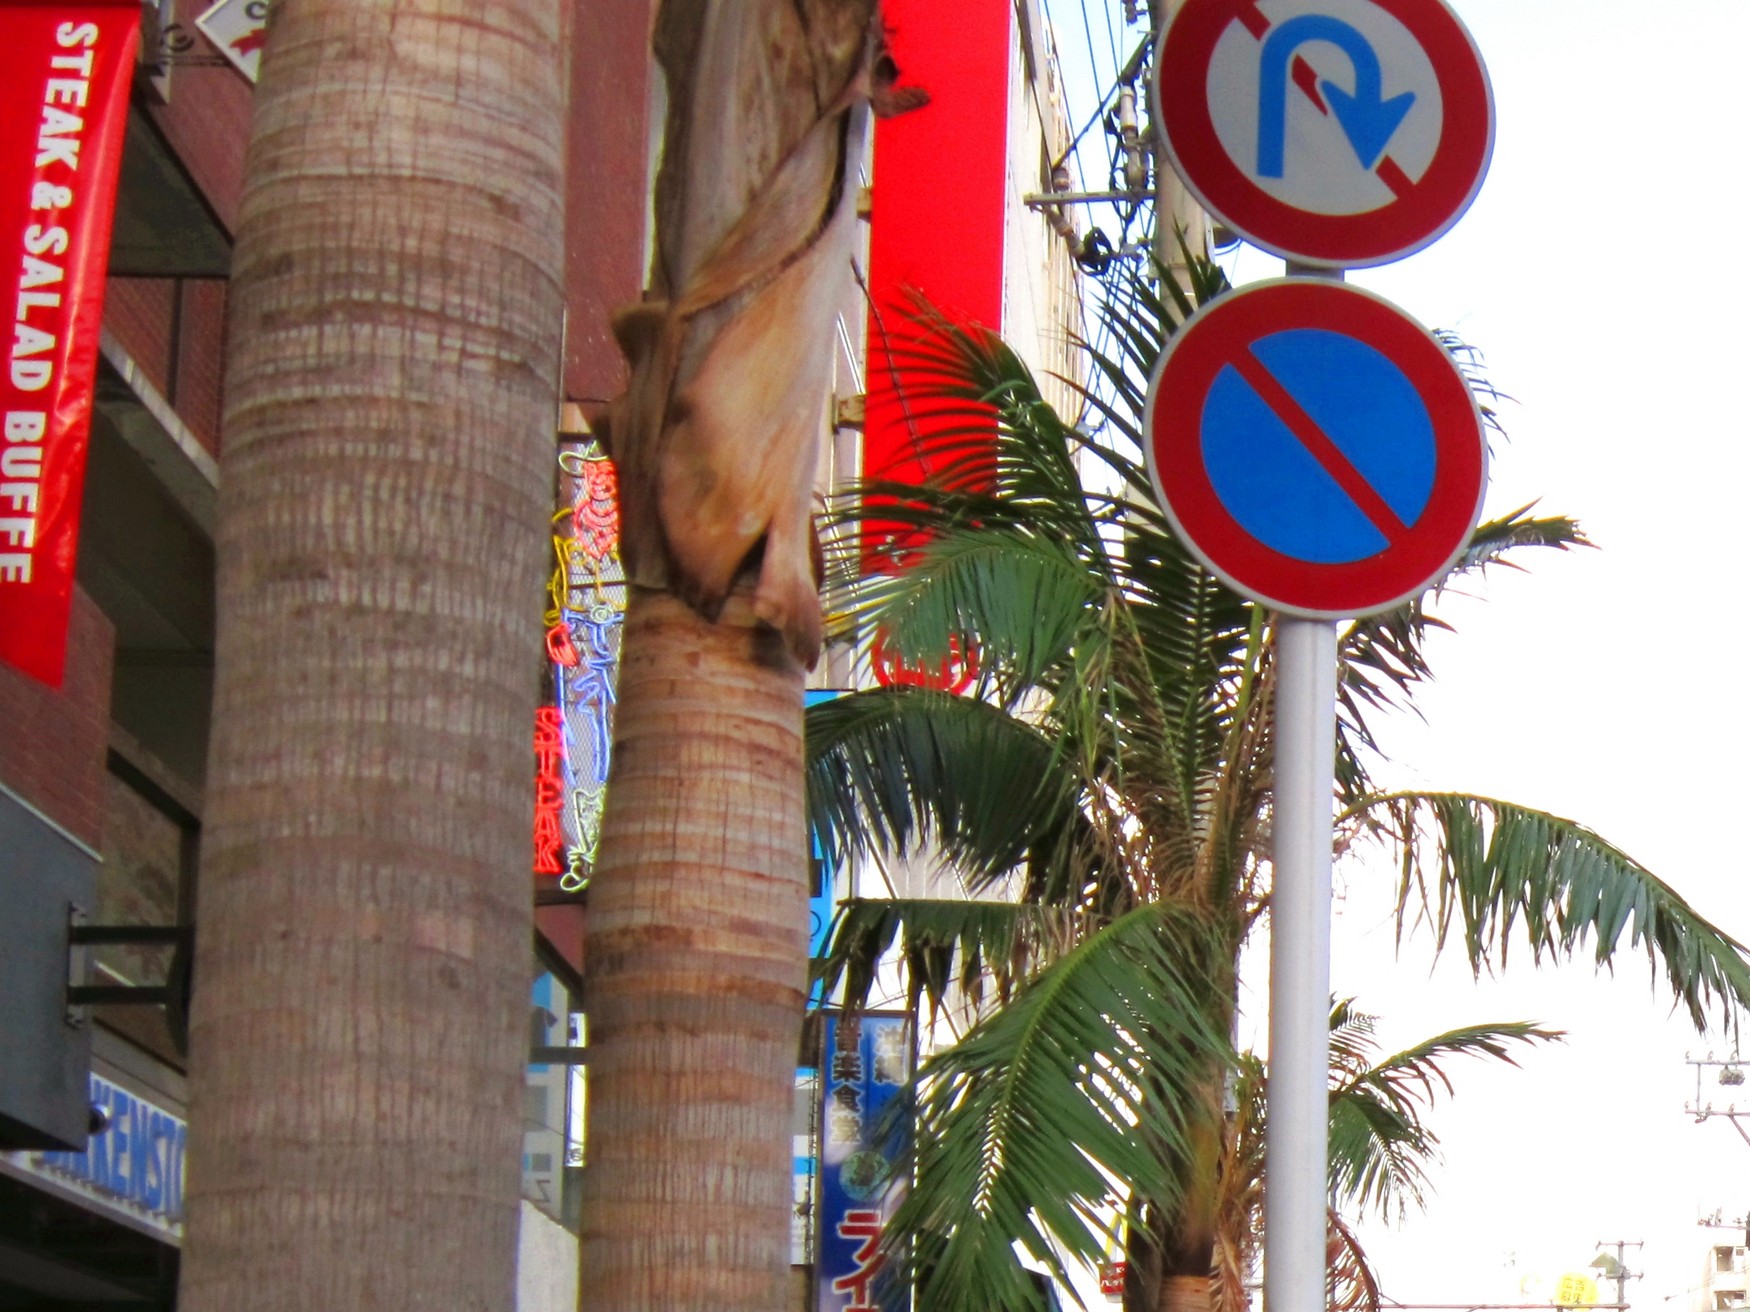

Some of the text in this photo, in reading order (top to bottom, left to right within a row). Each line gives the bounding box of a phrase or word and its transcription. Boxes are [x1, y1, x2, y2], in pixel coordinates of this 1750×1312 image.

[0, 22, 98, 585] STEAK & SALAD BUFFE
[534, 706, 563, 874] STEAK
